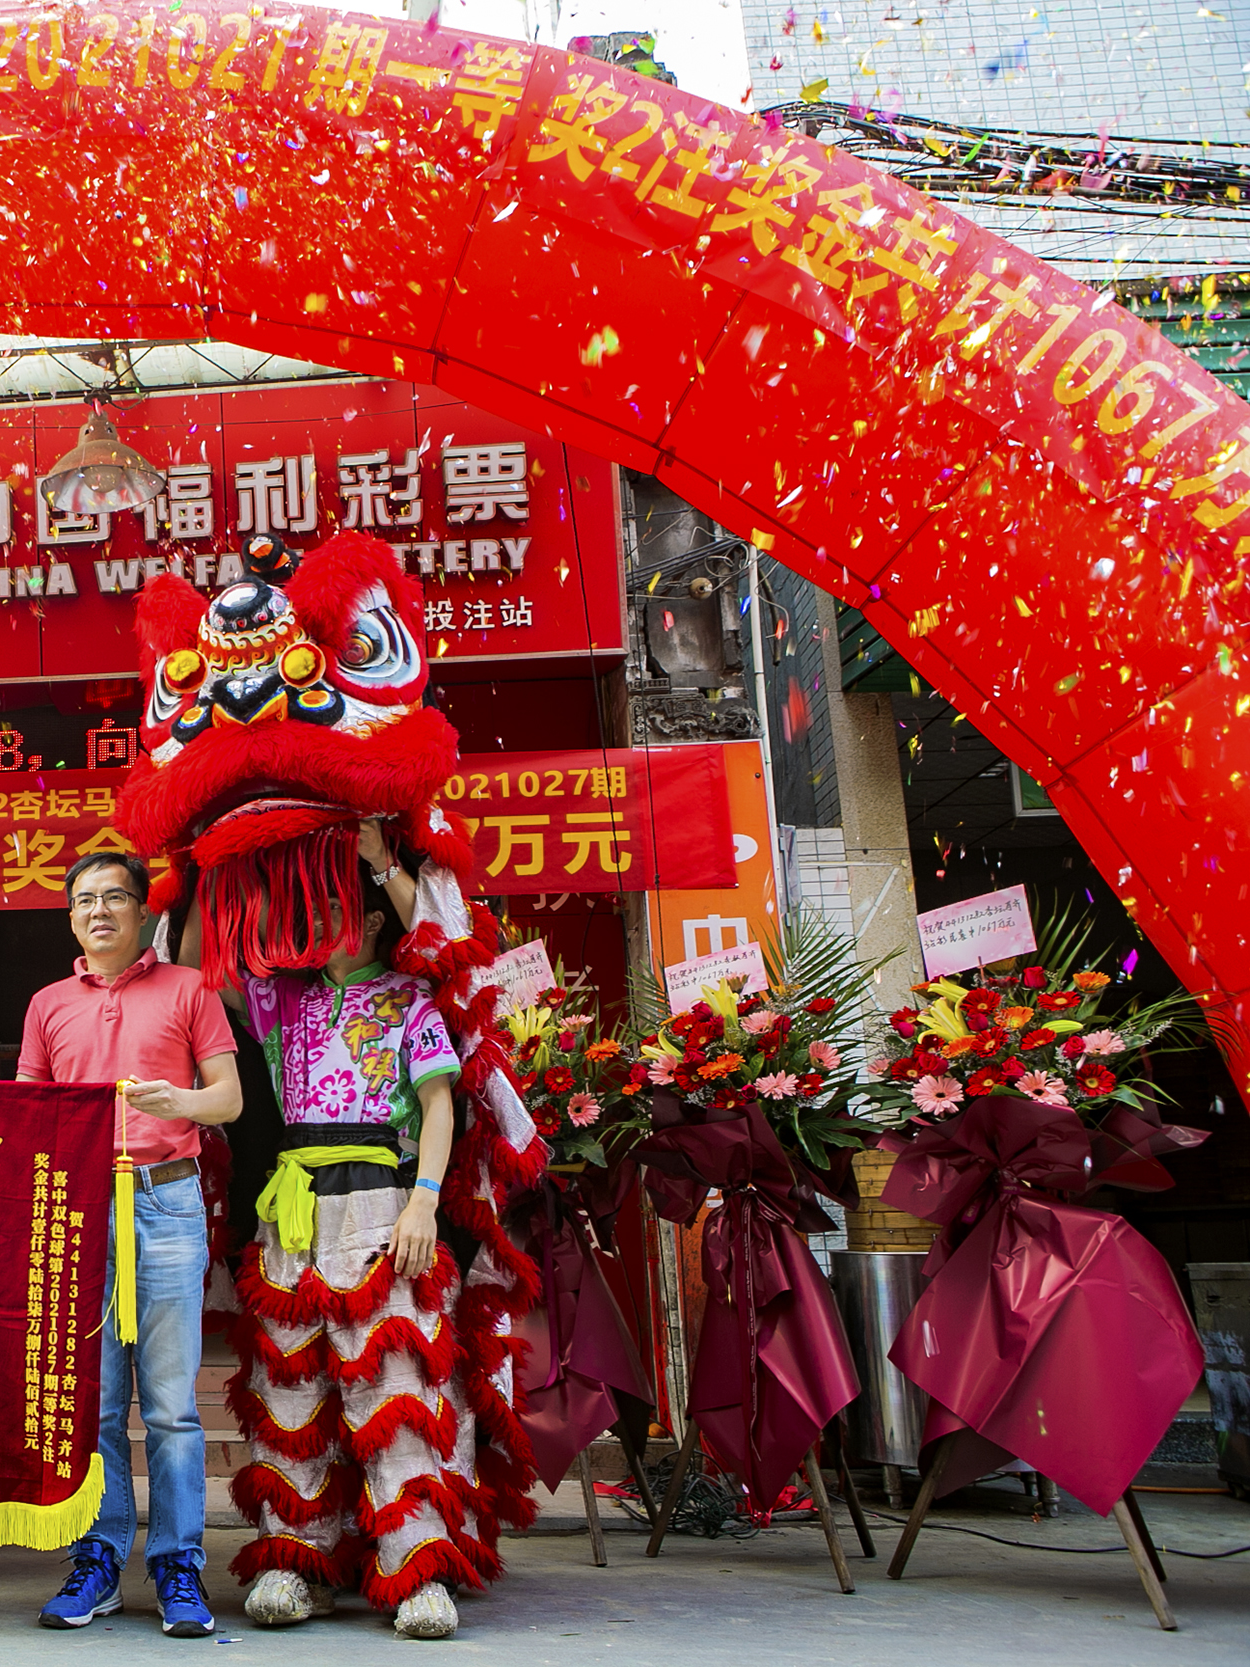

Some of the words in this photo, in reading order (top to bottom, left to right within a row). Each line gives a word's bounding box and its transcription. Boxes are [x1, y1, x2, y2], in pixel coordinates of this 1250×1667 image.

[93, 547, 305, 593] WELFA
[424, 595, 534, 632] 投注站
[434, 766, 627, 801] 021027期
[464, 811, 633, 878] 万元
[41, 1170, 69, 1464] 喜中双色球第2021027期一等奖2注
[56, 1210, 85, 1480] 贺44131282杏坛马齐站
